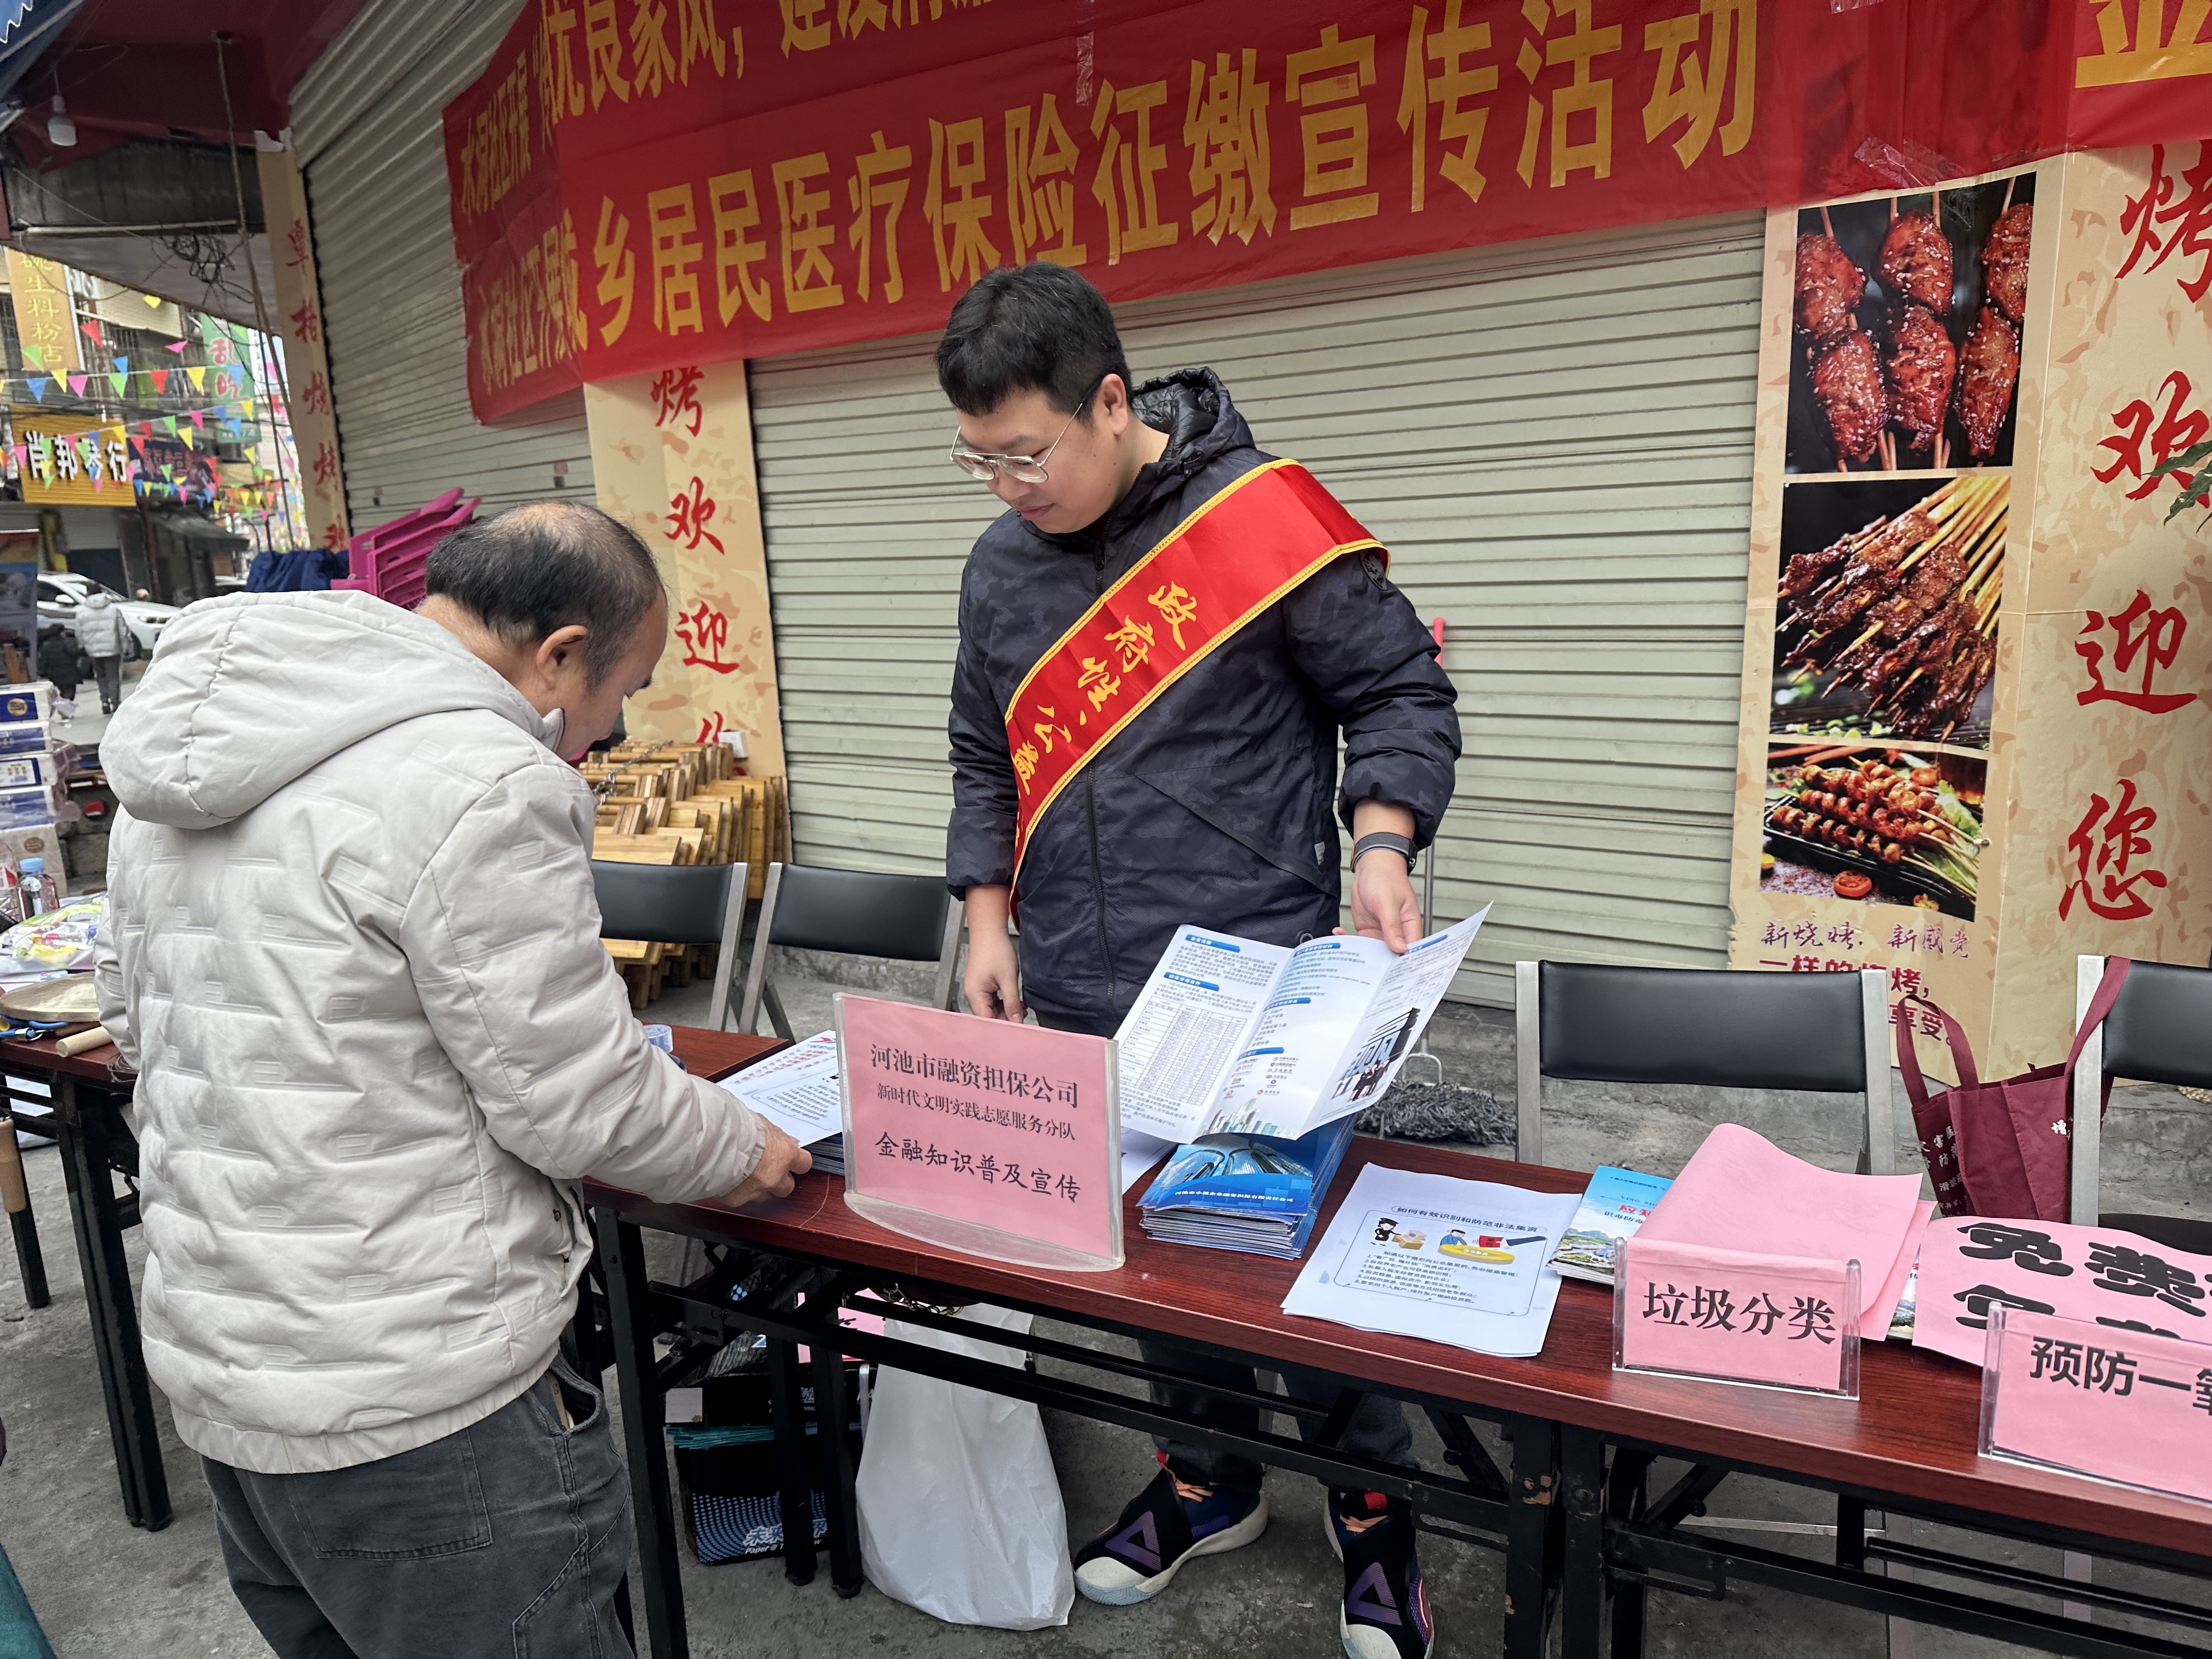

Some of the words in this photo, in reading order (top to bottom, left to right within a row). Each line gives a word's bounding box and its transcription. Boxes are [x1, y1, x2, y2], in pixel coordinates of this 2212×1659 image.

[1759, 955, 1931, 999] 一样烤，
[870, 1043, 1080, 1109] 河池市融资担保公司
[876, 1082, 1077, 1142] 新时代文明实践志愿服务分队
[874, 1131, 1082, 1203] 金融知识普及宣传
[1396, 1206, 1538, 1233] 如何有效识别和防范非法集资
[1957, 1222, 2212, 1317] 免费
[1643, 1282, 1836, 1344] 垃圾分类
